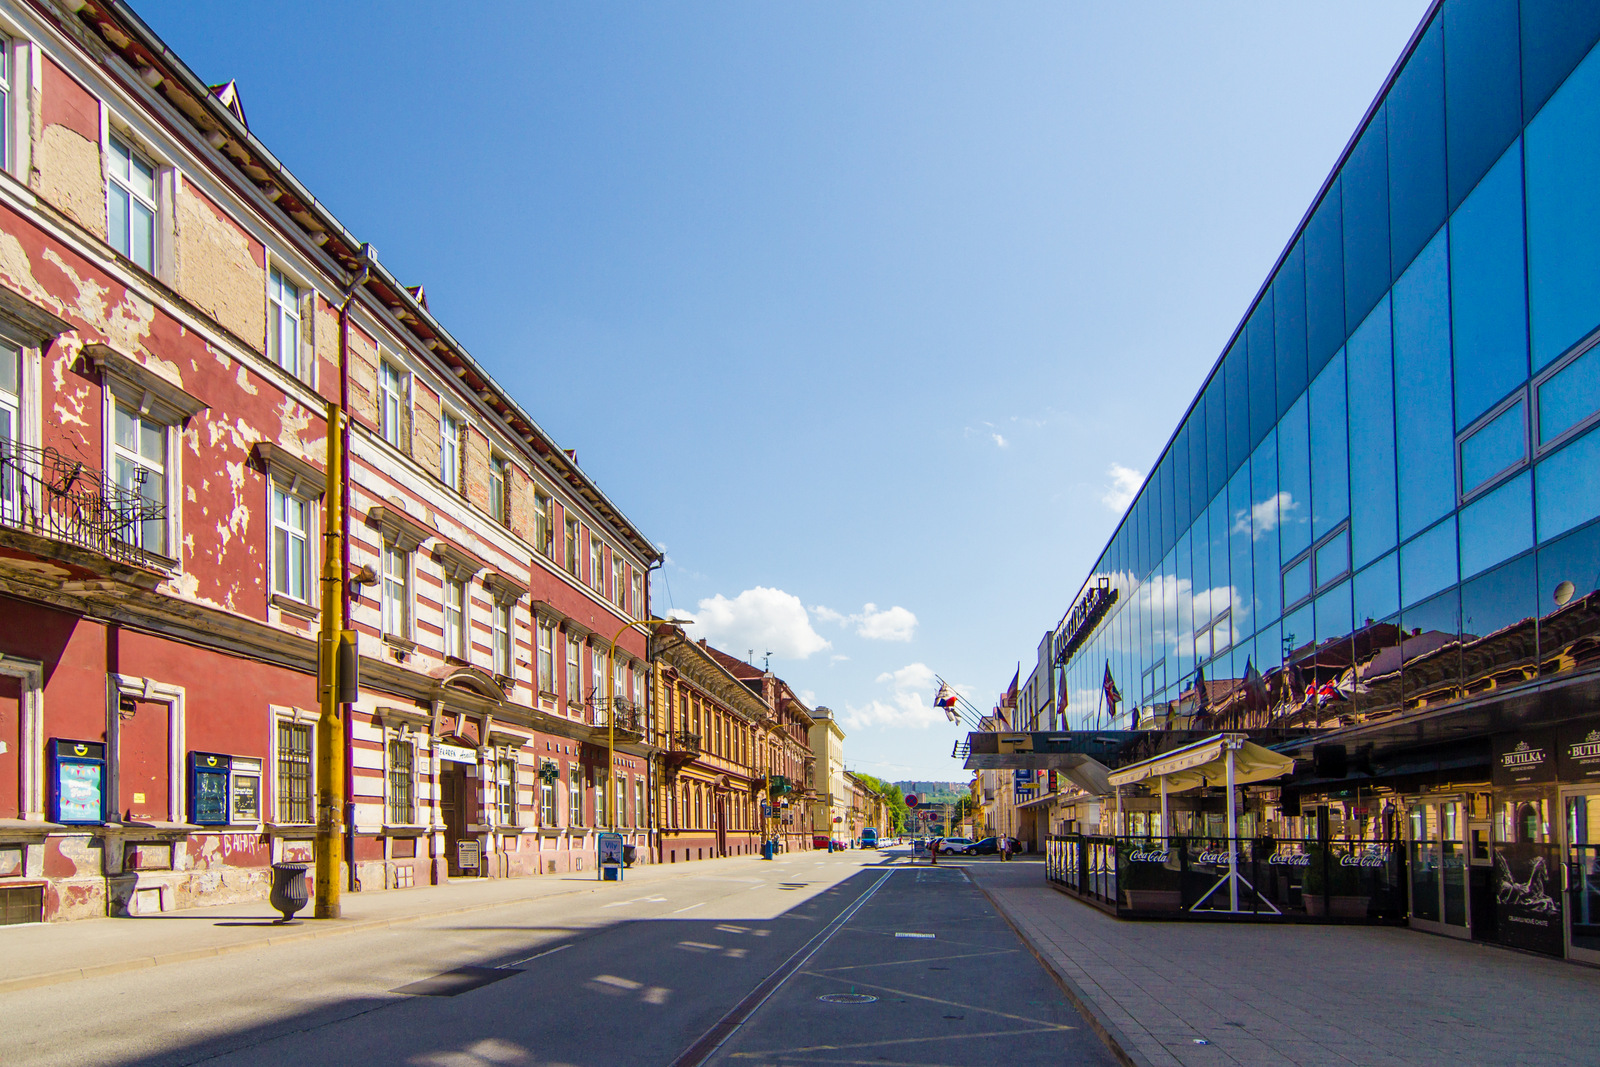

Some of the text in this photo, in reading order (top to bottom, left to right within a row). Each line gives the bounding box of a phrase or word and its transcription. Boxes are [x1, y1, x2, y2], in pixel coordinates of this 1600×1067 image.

[1504, 751, 1542, 765] BUTILKA
[1129, 849, 1169, 862] Coca-Cola
[1268, 852, 1311, 866] Coca-Cola
[1339, 853, 1383, 867] Coca-Cola
